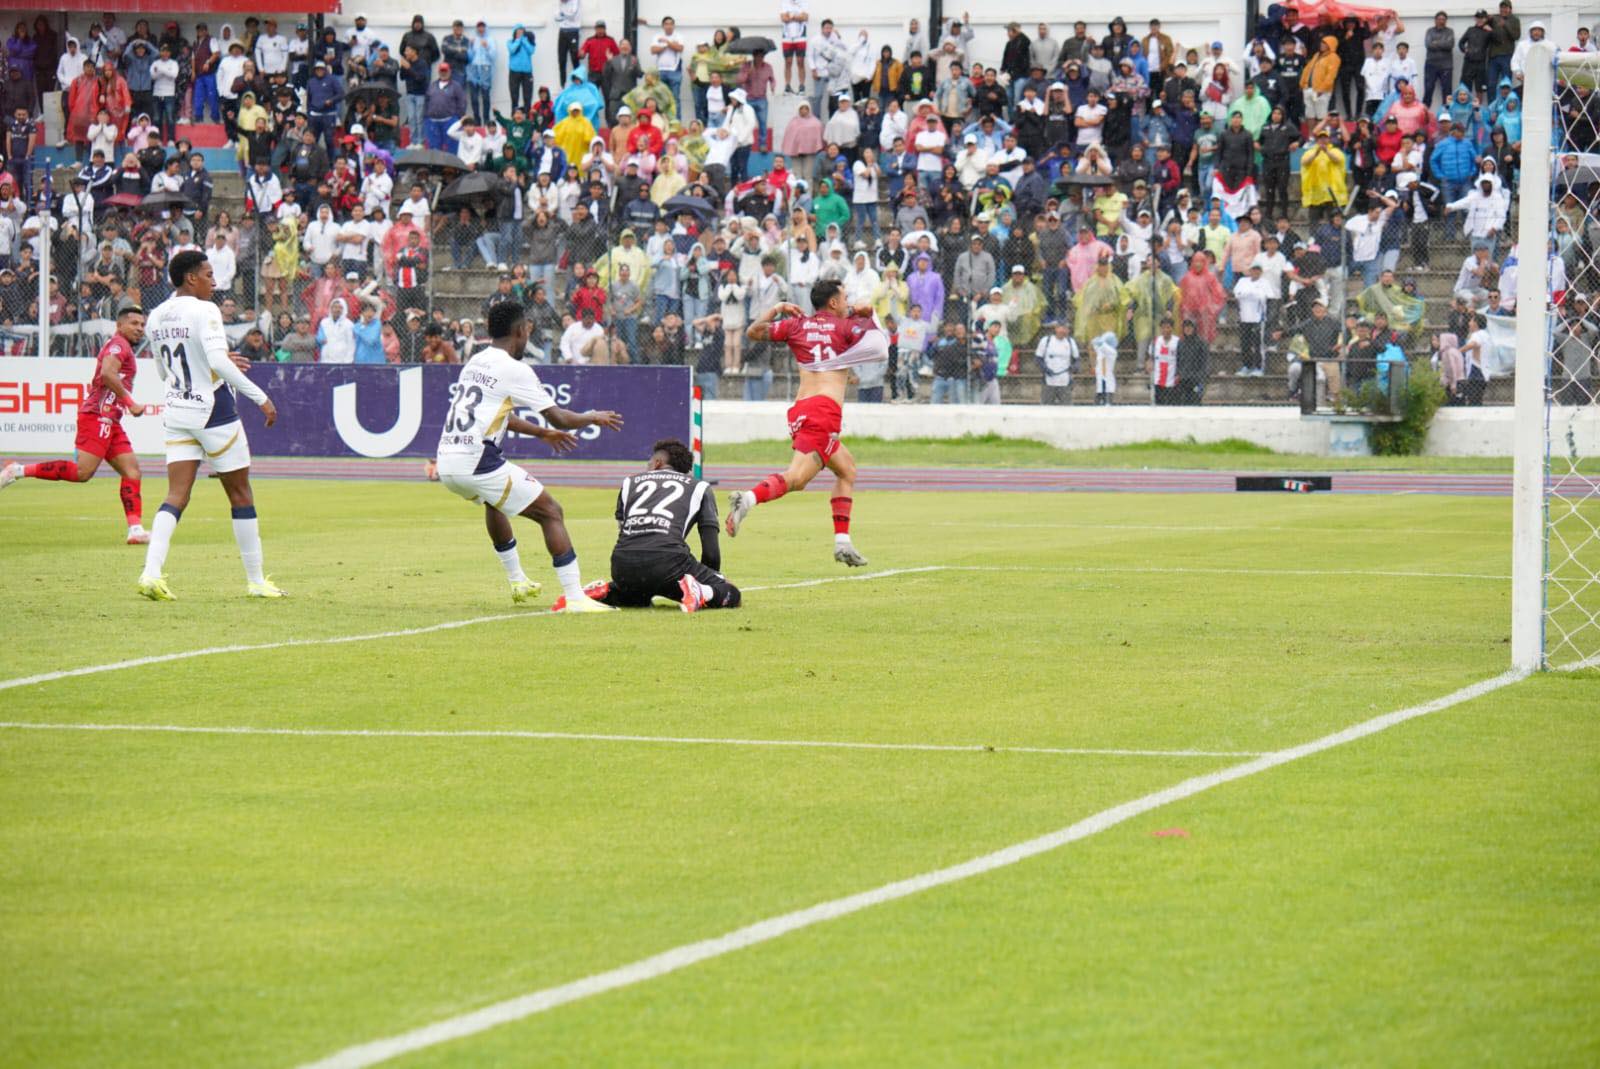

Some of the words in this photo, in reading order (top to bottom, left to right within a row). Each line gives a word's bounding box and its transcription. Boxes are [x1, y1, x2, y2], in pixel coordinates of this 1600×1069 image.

[161, 328, 169, 340] LA
[171, 327, 190, 339] CRUZ
[160, 342, 192, 392] 21
[0, 382, 92, 414] SHA
[4, 423, 16, 432] DE
[18, 423, 56, 432] AHORRO
[57, 424, 62, 432] Y
[64, 423, 76, 432] CR
[98, 423, 111, 439] 19
[634, 473, 692, 485] DOMINGUEZ
[628, 480, 685, 519] 22
[624, 516, 671, 529] DISCOVER
